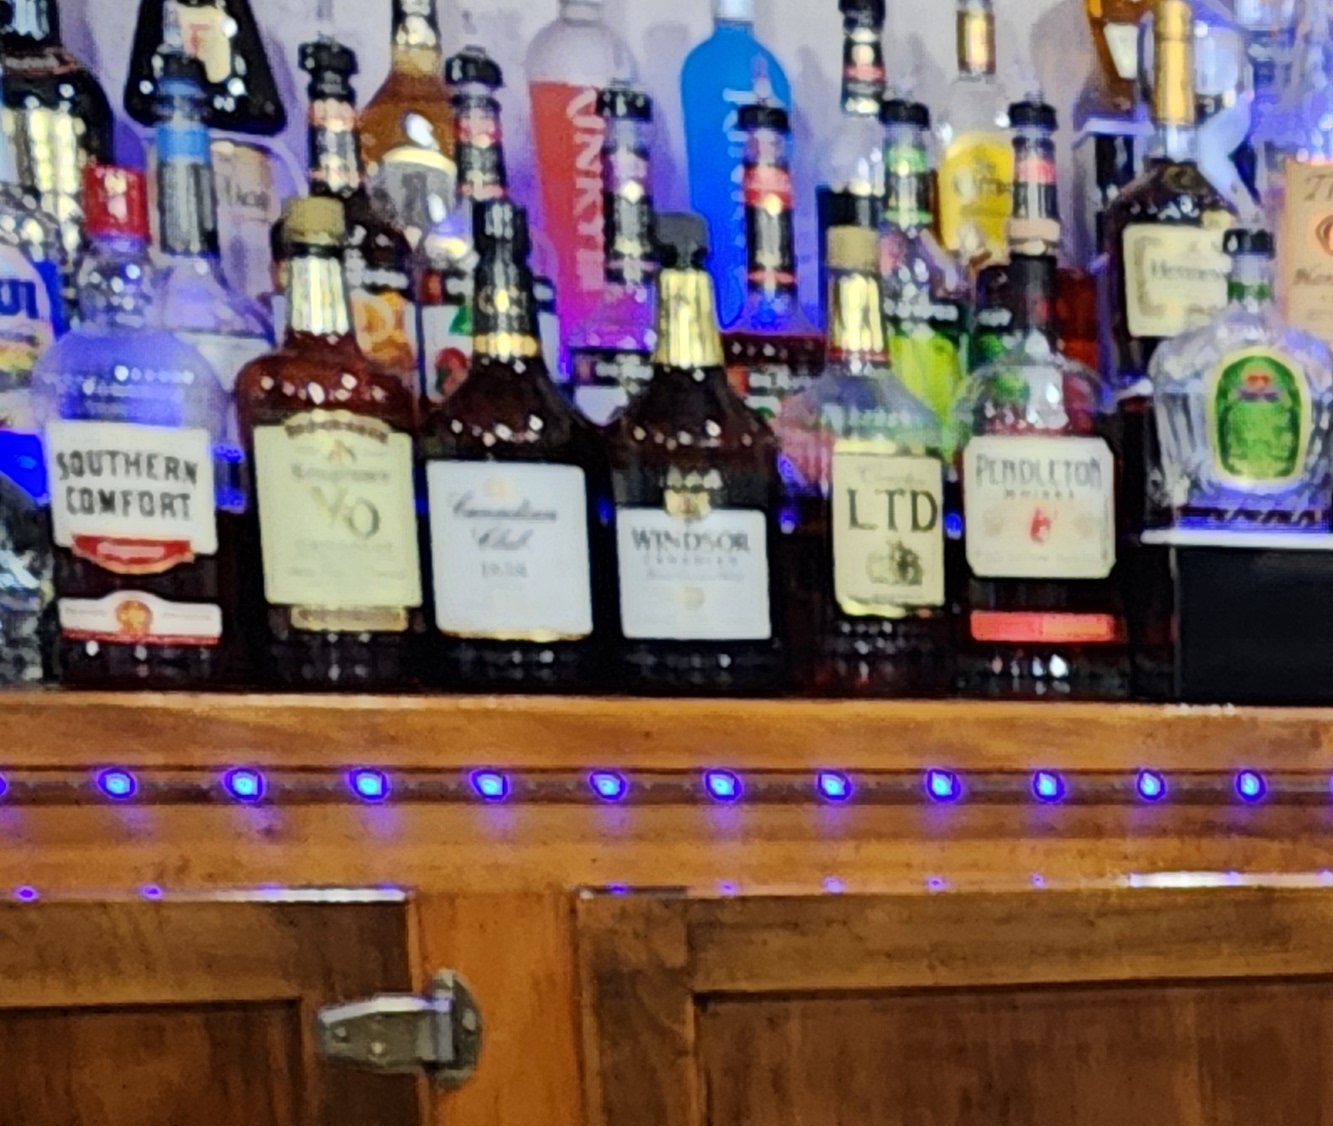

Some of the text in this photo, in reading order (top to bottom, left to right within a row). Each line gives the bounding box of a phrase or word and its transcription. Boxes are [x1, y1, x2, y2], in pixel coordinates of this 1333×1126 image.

[55, 450, 199, 485] SOUTHERN
[975, 453, 1104, 489] PENDLETON
[65, 485, 192, 520] COMFORT
[846, 488, 938, 533] LTD
[631, 526, 750, 553] WINDSOR
